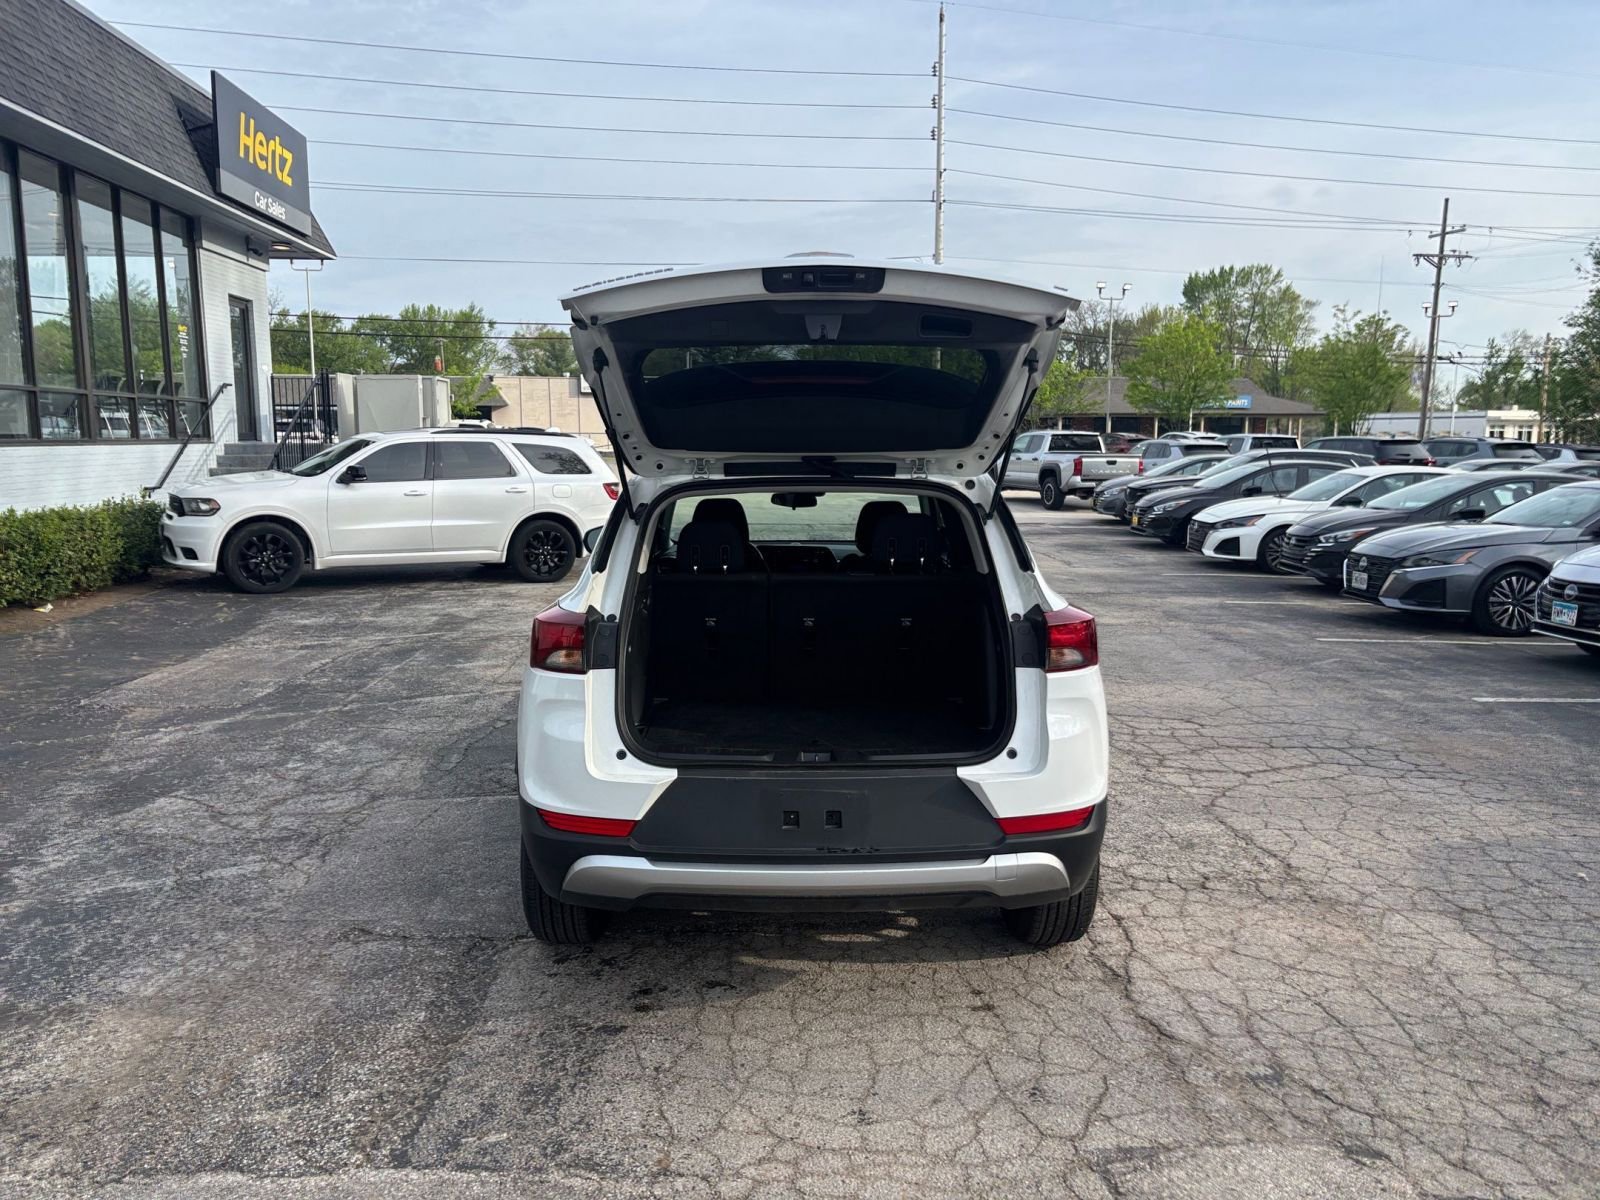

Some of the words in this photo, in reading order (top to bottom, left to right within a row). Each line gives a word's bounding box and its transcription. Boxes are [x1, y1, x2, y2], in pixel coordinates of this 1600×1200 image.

[239, 111, 293, 187] Hertz
[254, 191, 267, 211] Car
[267, 198, 286, 220] Sales
